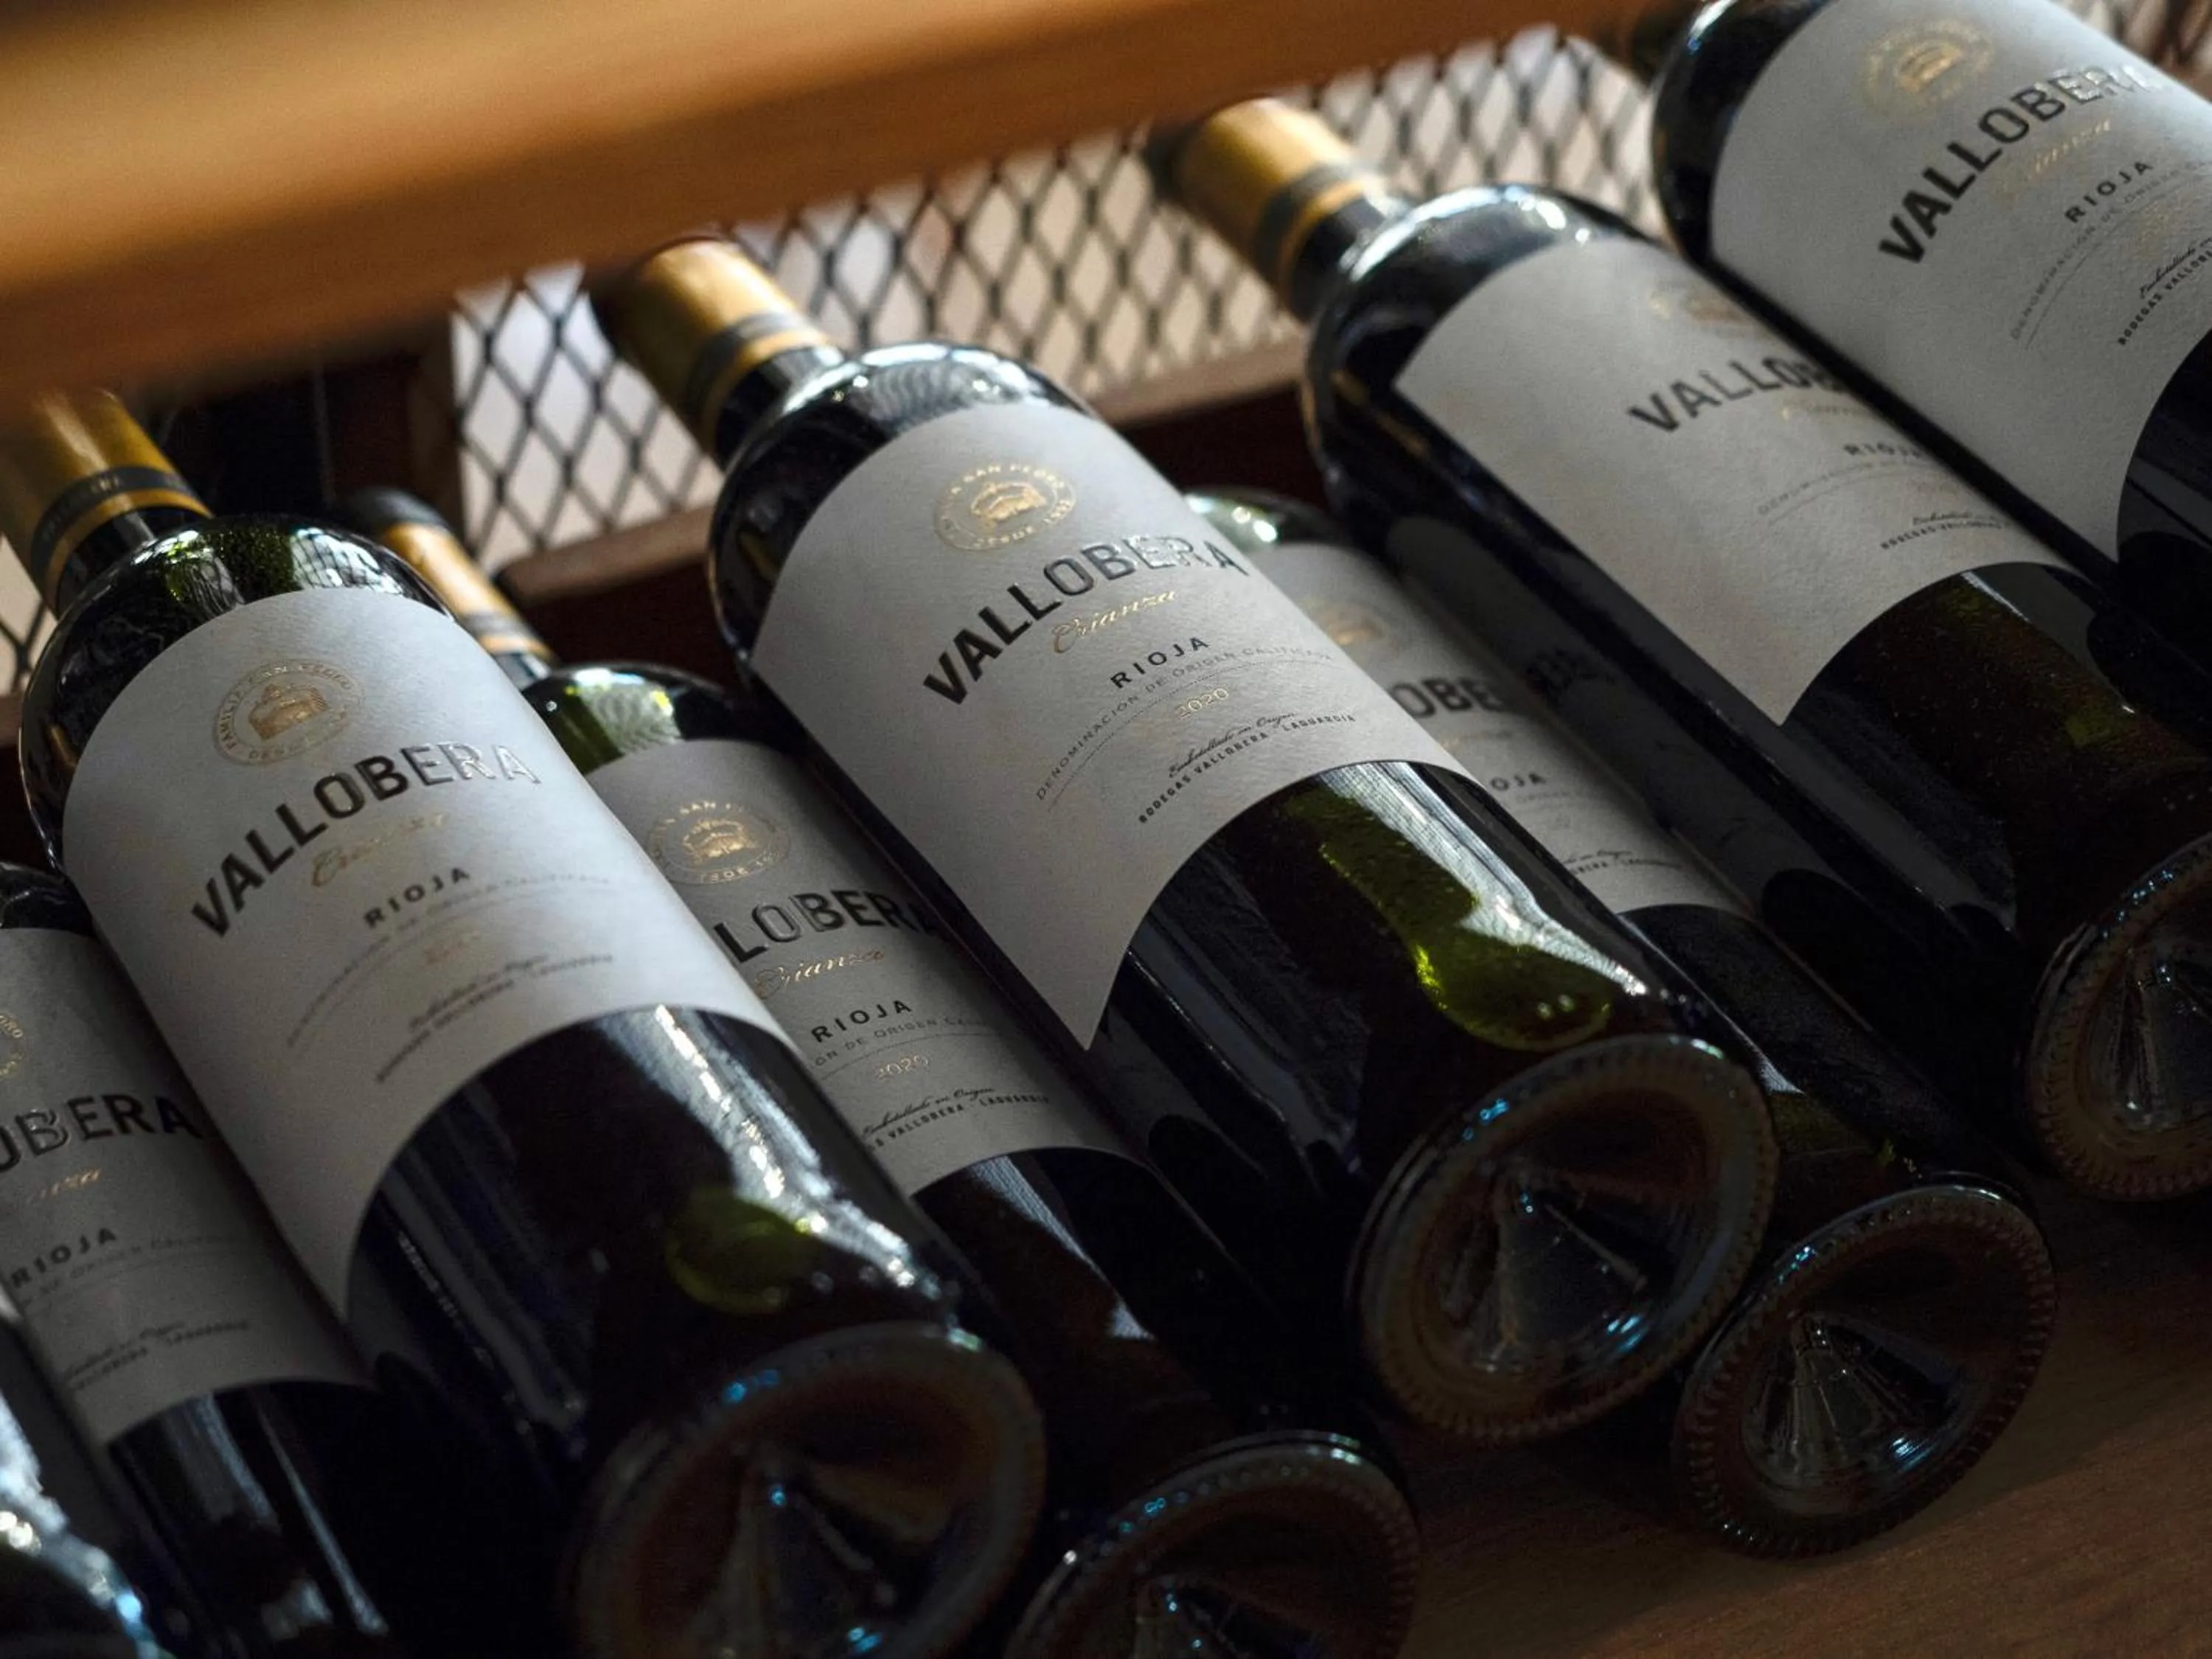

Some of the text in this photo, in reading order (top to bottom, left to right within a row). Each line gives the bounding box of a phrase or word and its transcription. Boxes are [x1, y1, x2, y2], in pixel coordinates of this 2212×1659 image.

[2065, 161, 2153, 223] RIOJA
[923, 535, 1250, 706] VALLOBERA
[1052, 591, 1176, 654] Crianza
[1110, 636, 1209, 689] RIOJA
[1175, 687, 1230, 720] 2020
[1138, 774, 1192, 824] BODEGAS
[1194, 731, 1269, 774] VALLOBERA
[1489, 771, 1547, 791] OJA
[190, 742, 541, 938] VALLOBERA
[364, 867, 470, 928] RIOJA
[812, 1000, 912, 1043] RIOJA
[10, 1227, 116, 1289] RIOJA
